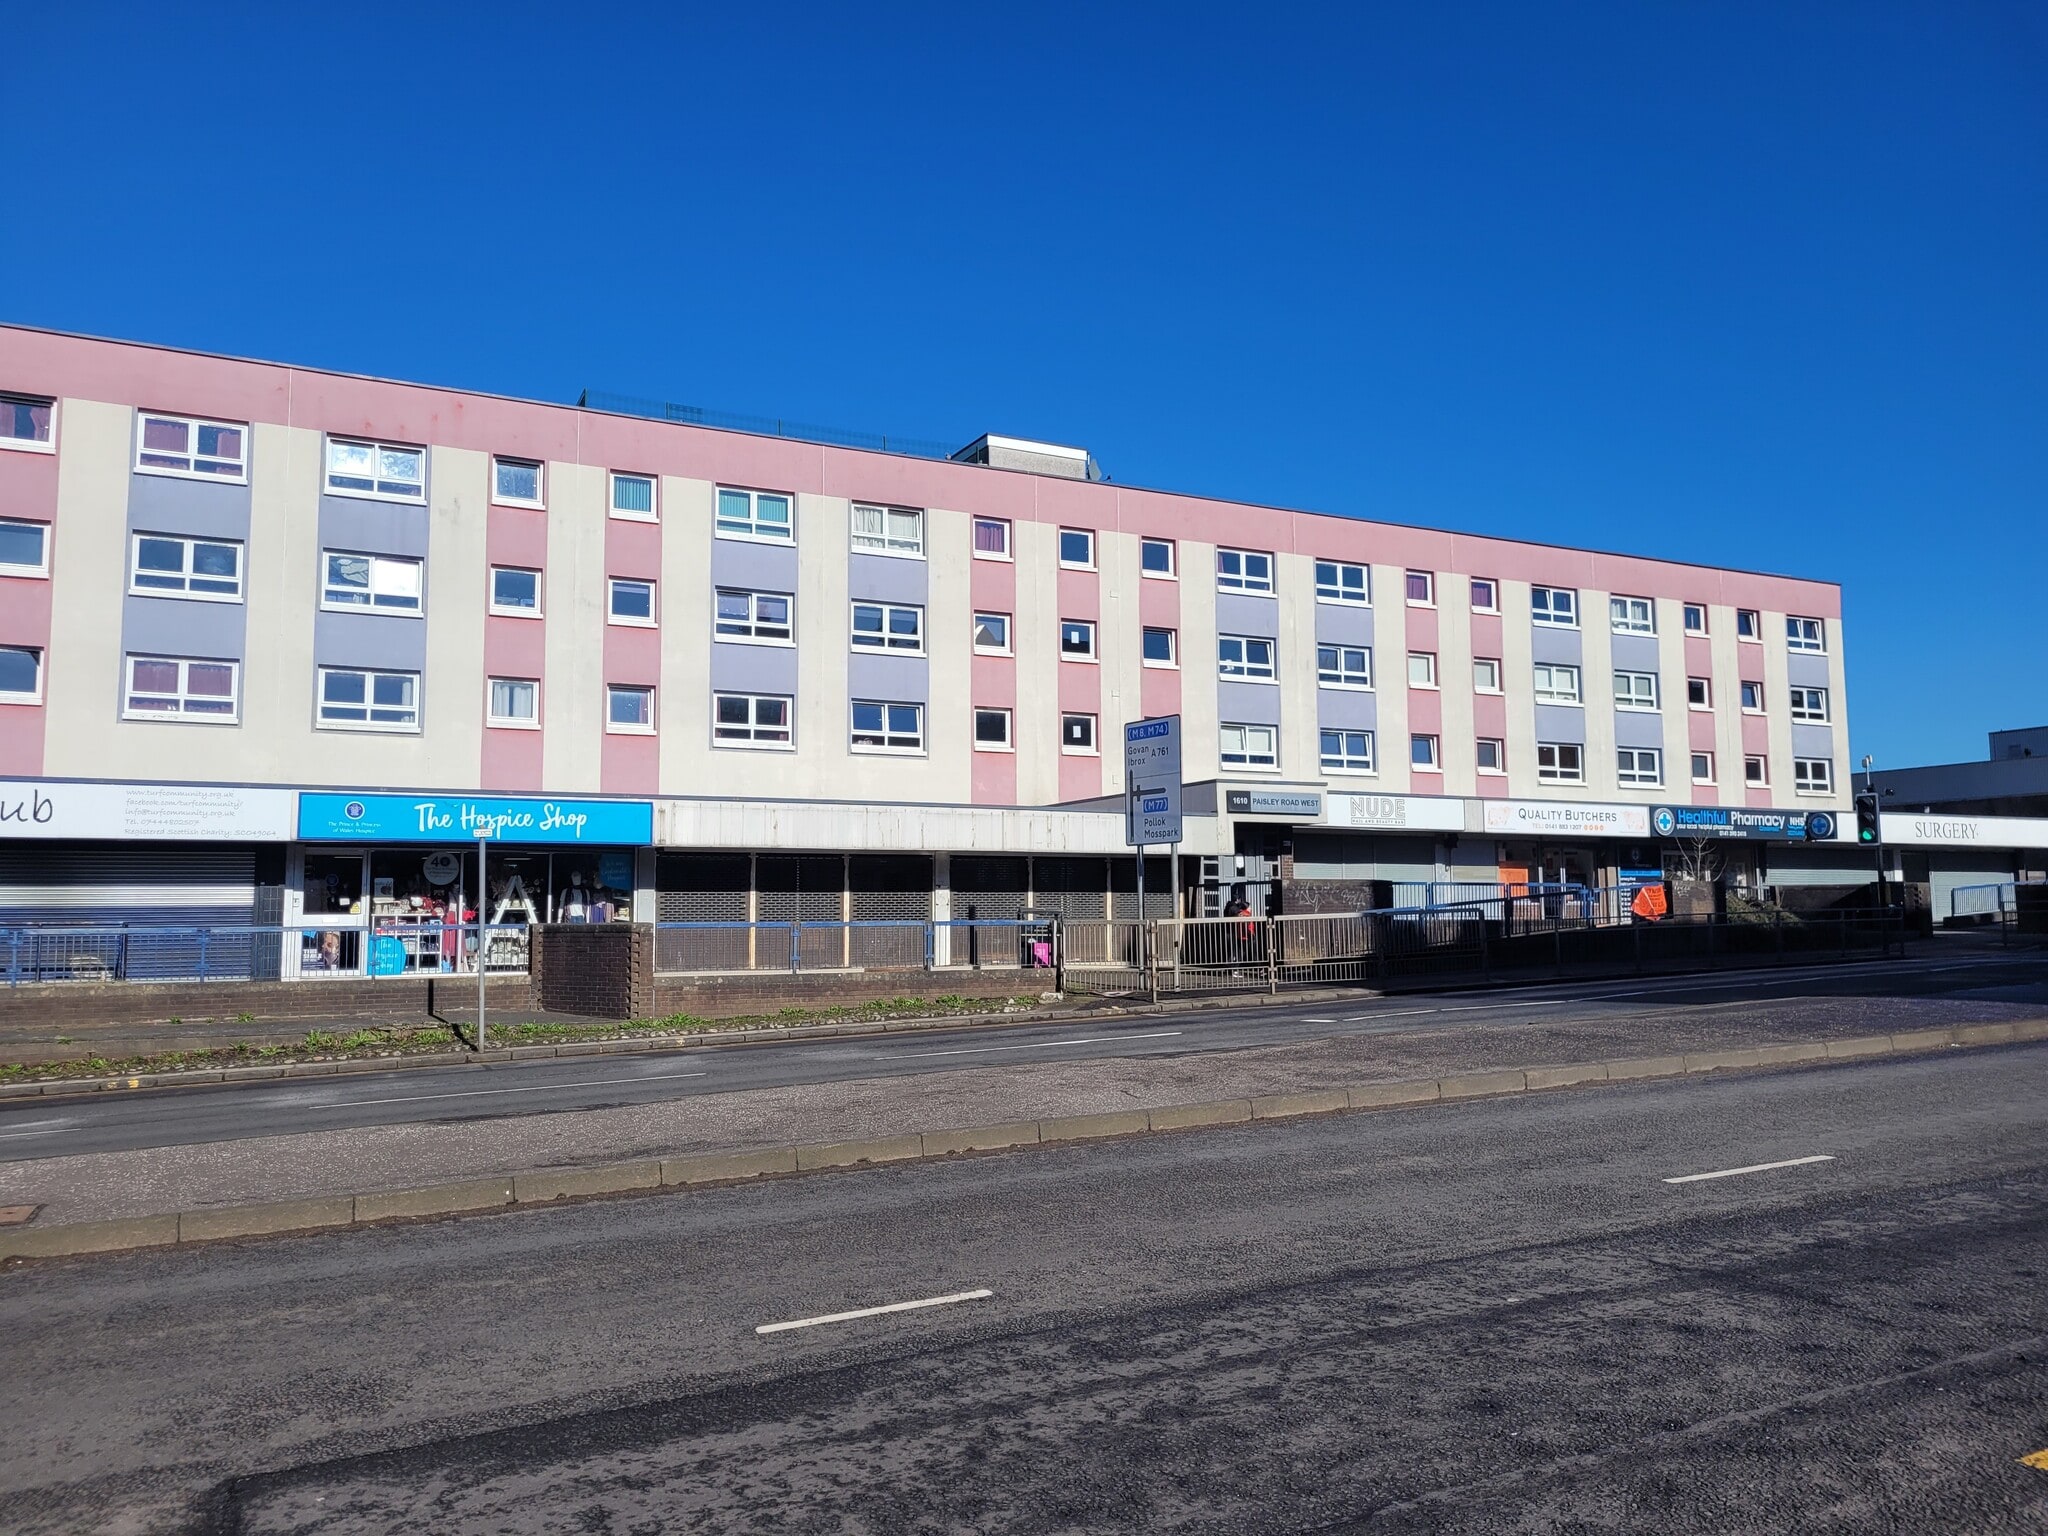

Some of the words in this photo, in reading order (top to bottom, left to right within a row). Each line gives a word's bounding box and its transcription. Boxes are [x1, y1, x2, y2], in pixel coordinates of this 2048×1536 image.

[1148, 722, 1168, 736] M74)
[1127, 746, 1149, 755] Govan
[1127, 758, 1146, 767] Ibrox
[1144, 799, 1168, 812] (M77)
[1253, 798, 1279, 806] PAISLEY
[1350, 797, 1406, 818] NUDE
[413, 803, 453, 833] The
[459, 802, 534, 840] Hospice
[539, 803, 588, 839] Shop
[1144, 818, 1166, 827] Pollok
[1677, 809, 1726, 824] Healthful
[1730, 811, 1785, 829] Pharmacy
[1789, 816, 1806, 826] NHS
[1144, 829, 1179, 839] Mosspark
[1914, 822, 1978, 839] SURGERY
